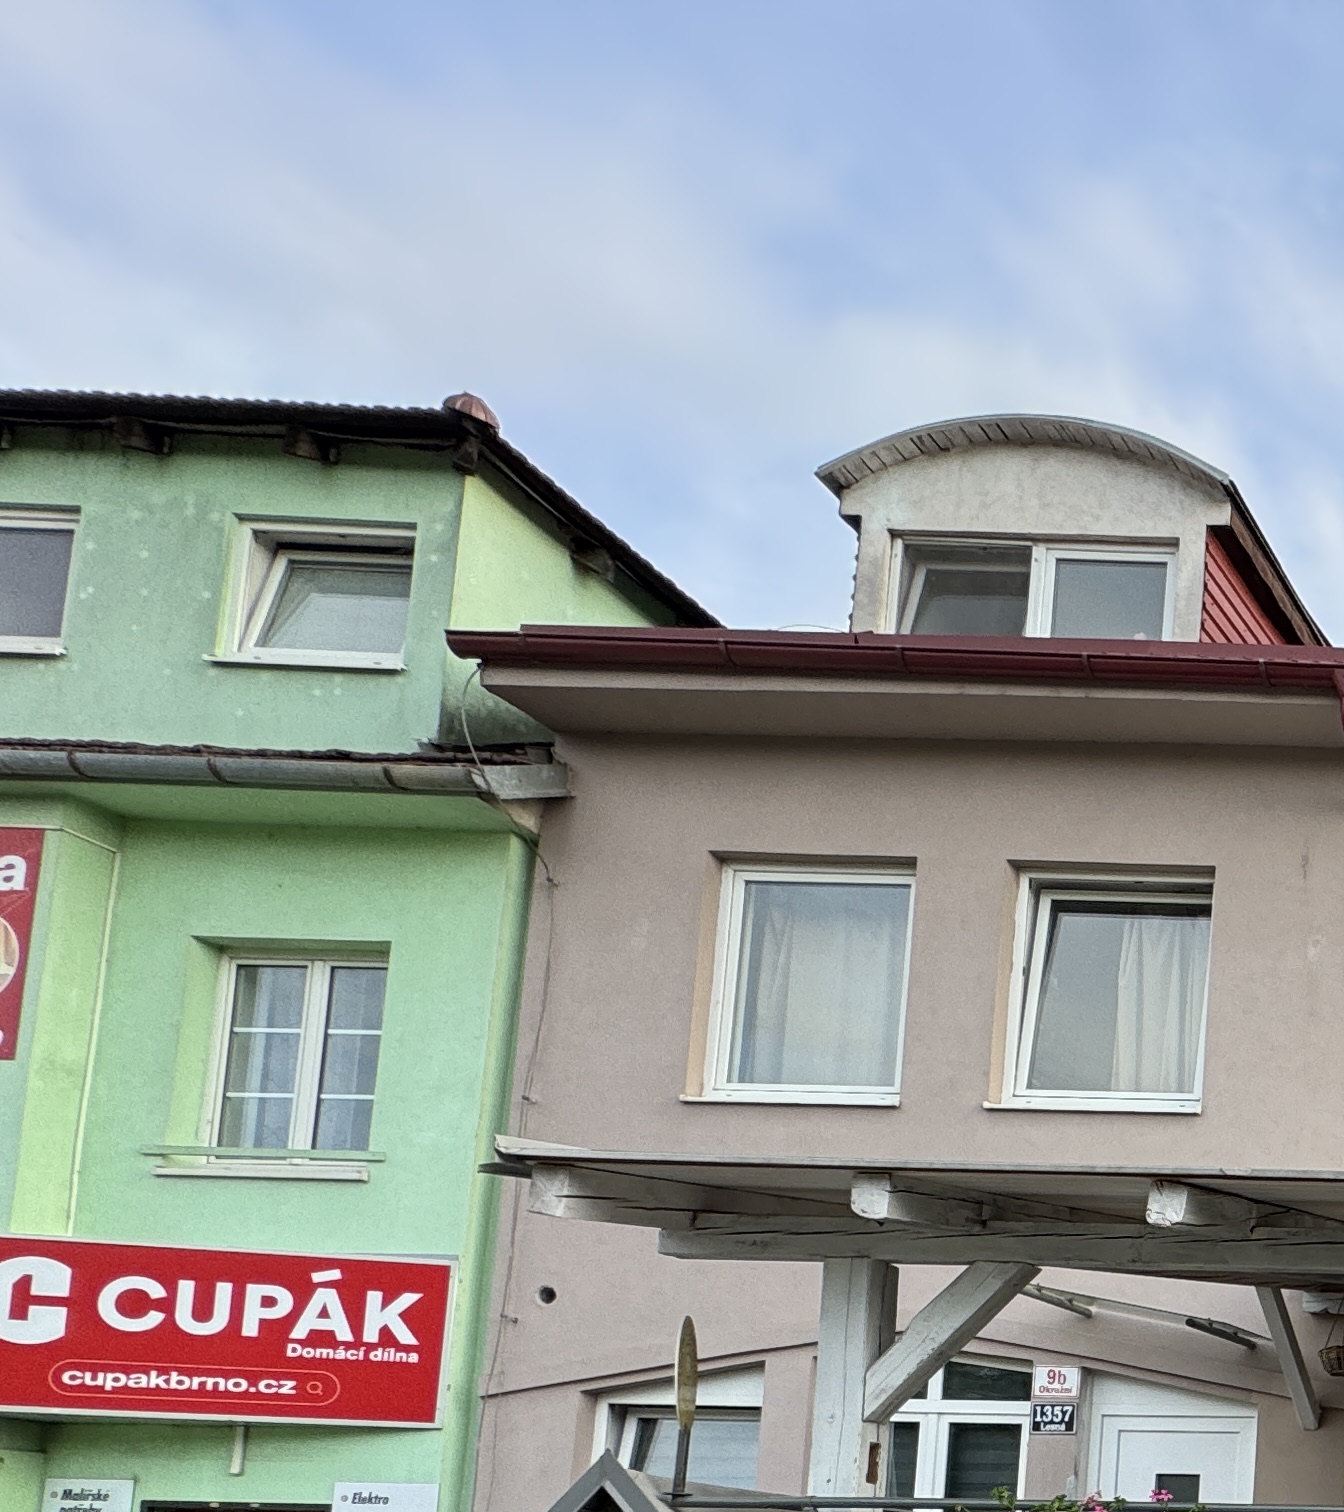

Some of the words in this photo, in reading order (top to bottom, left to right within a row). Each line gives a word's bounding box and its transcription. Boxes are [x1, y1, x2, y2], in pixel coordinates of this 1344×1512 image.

[96, 1268, 425, 1346] CUPÁK
[286, 1342, 365, 1363] Domácí
[369, 1346, 420, 1364] dílna
[61, 1366, 297, 1397] cupakbrno.cz
[1046, 1369, 1067, 1385] 9b
[1034, 1405, 1074, 1422] 1357
[350, 1492, 390, 1506] Elektro
